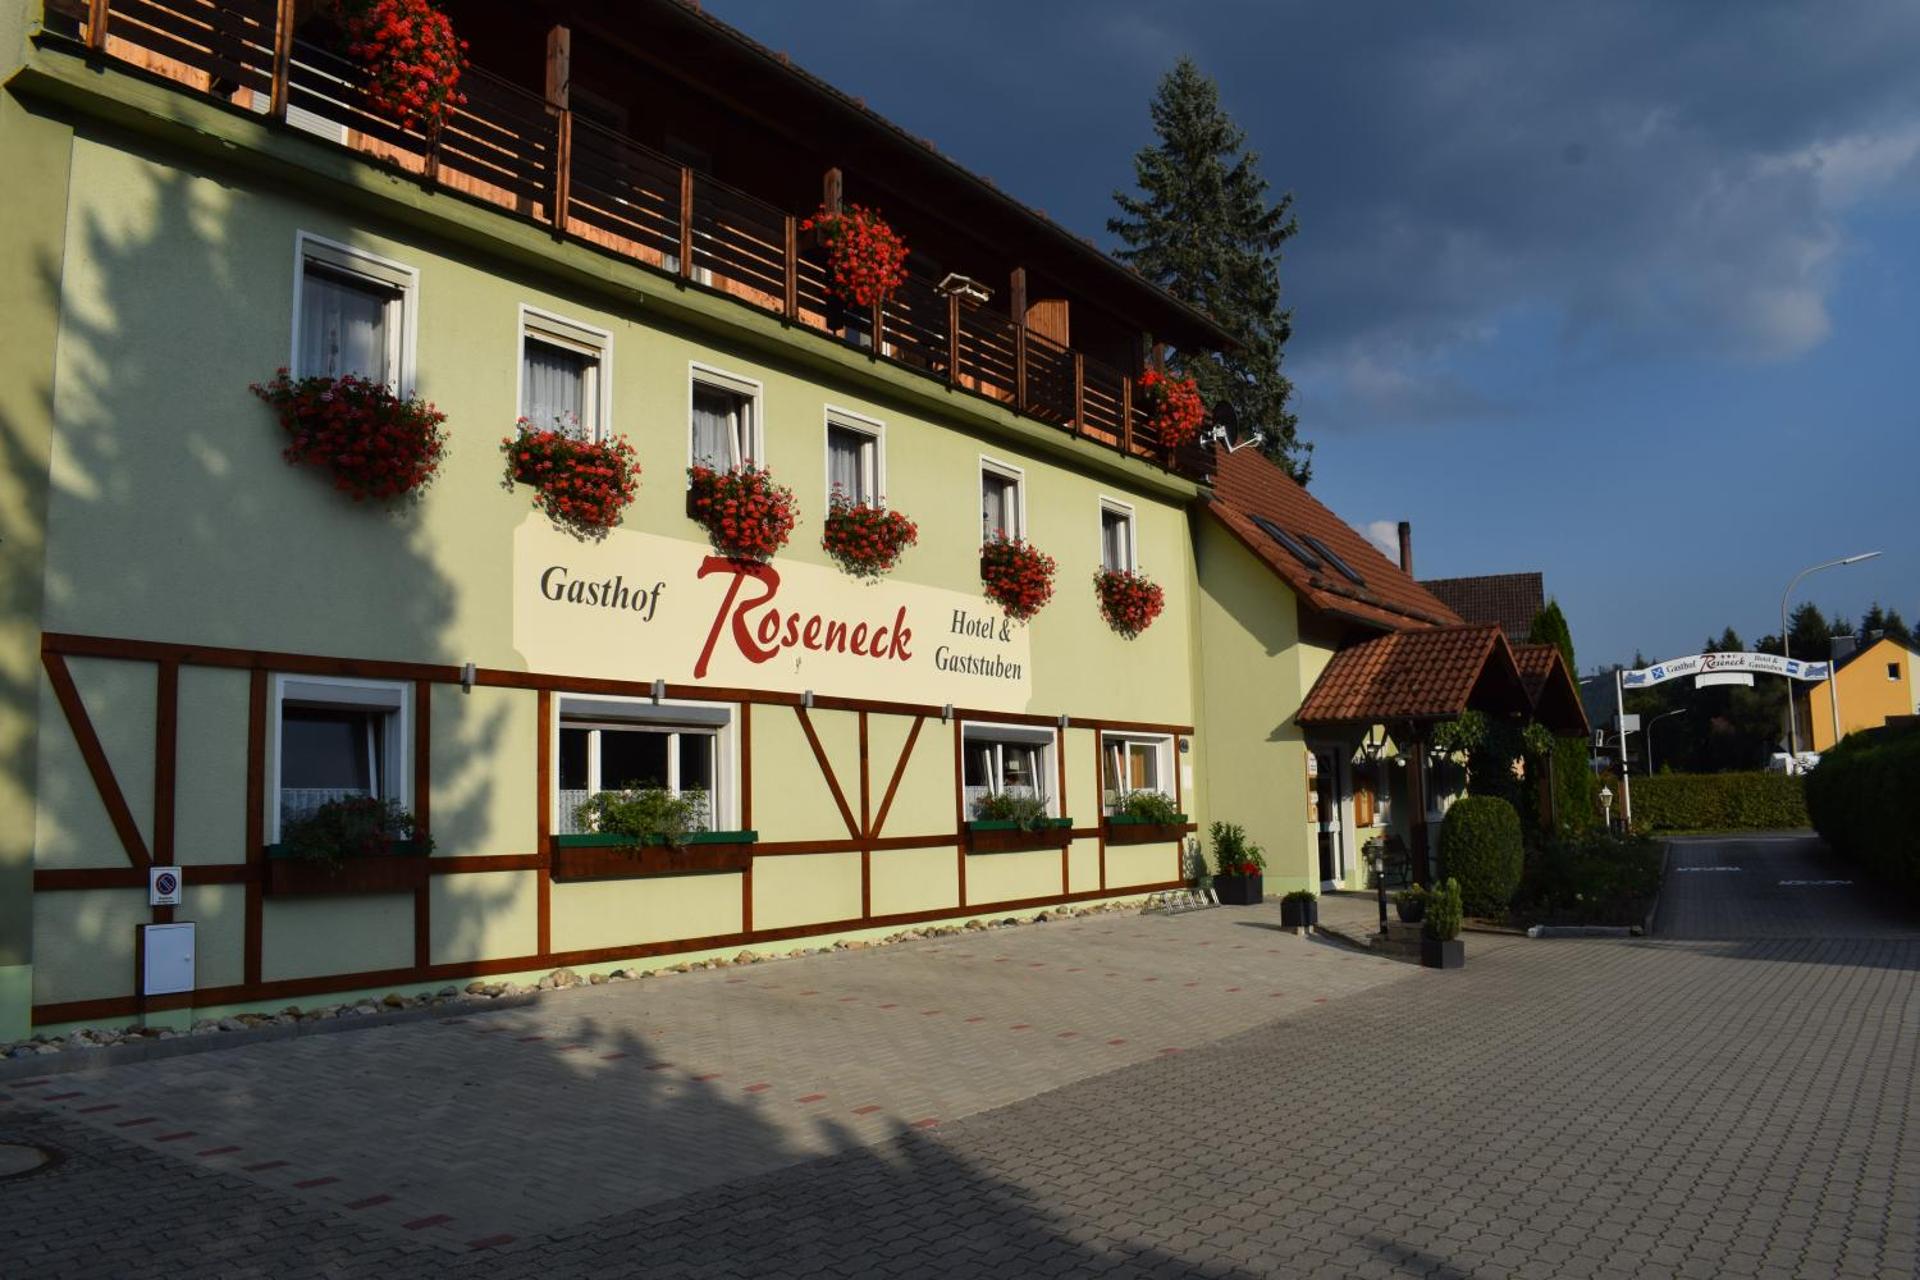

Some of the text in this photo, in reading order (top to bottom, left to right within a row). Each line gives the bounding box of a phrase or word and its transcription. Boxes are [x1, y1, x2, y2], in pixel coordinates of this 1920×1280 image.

[540, 565, 667, 622] Gasthof
[693, 555, 913, 679] Roseneck
[950, 609, 1011, 642] Hotel &
[934, 645, 1023, 681] Gaststuben
[1700, 655, 1747, 672] Roseneck
